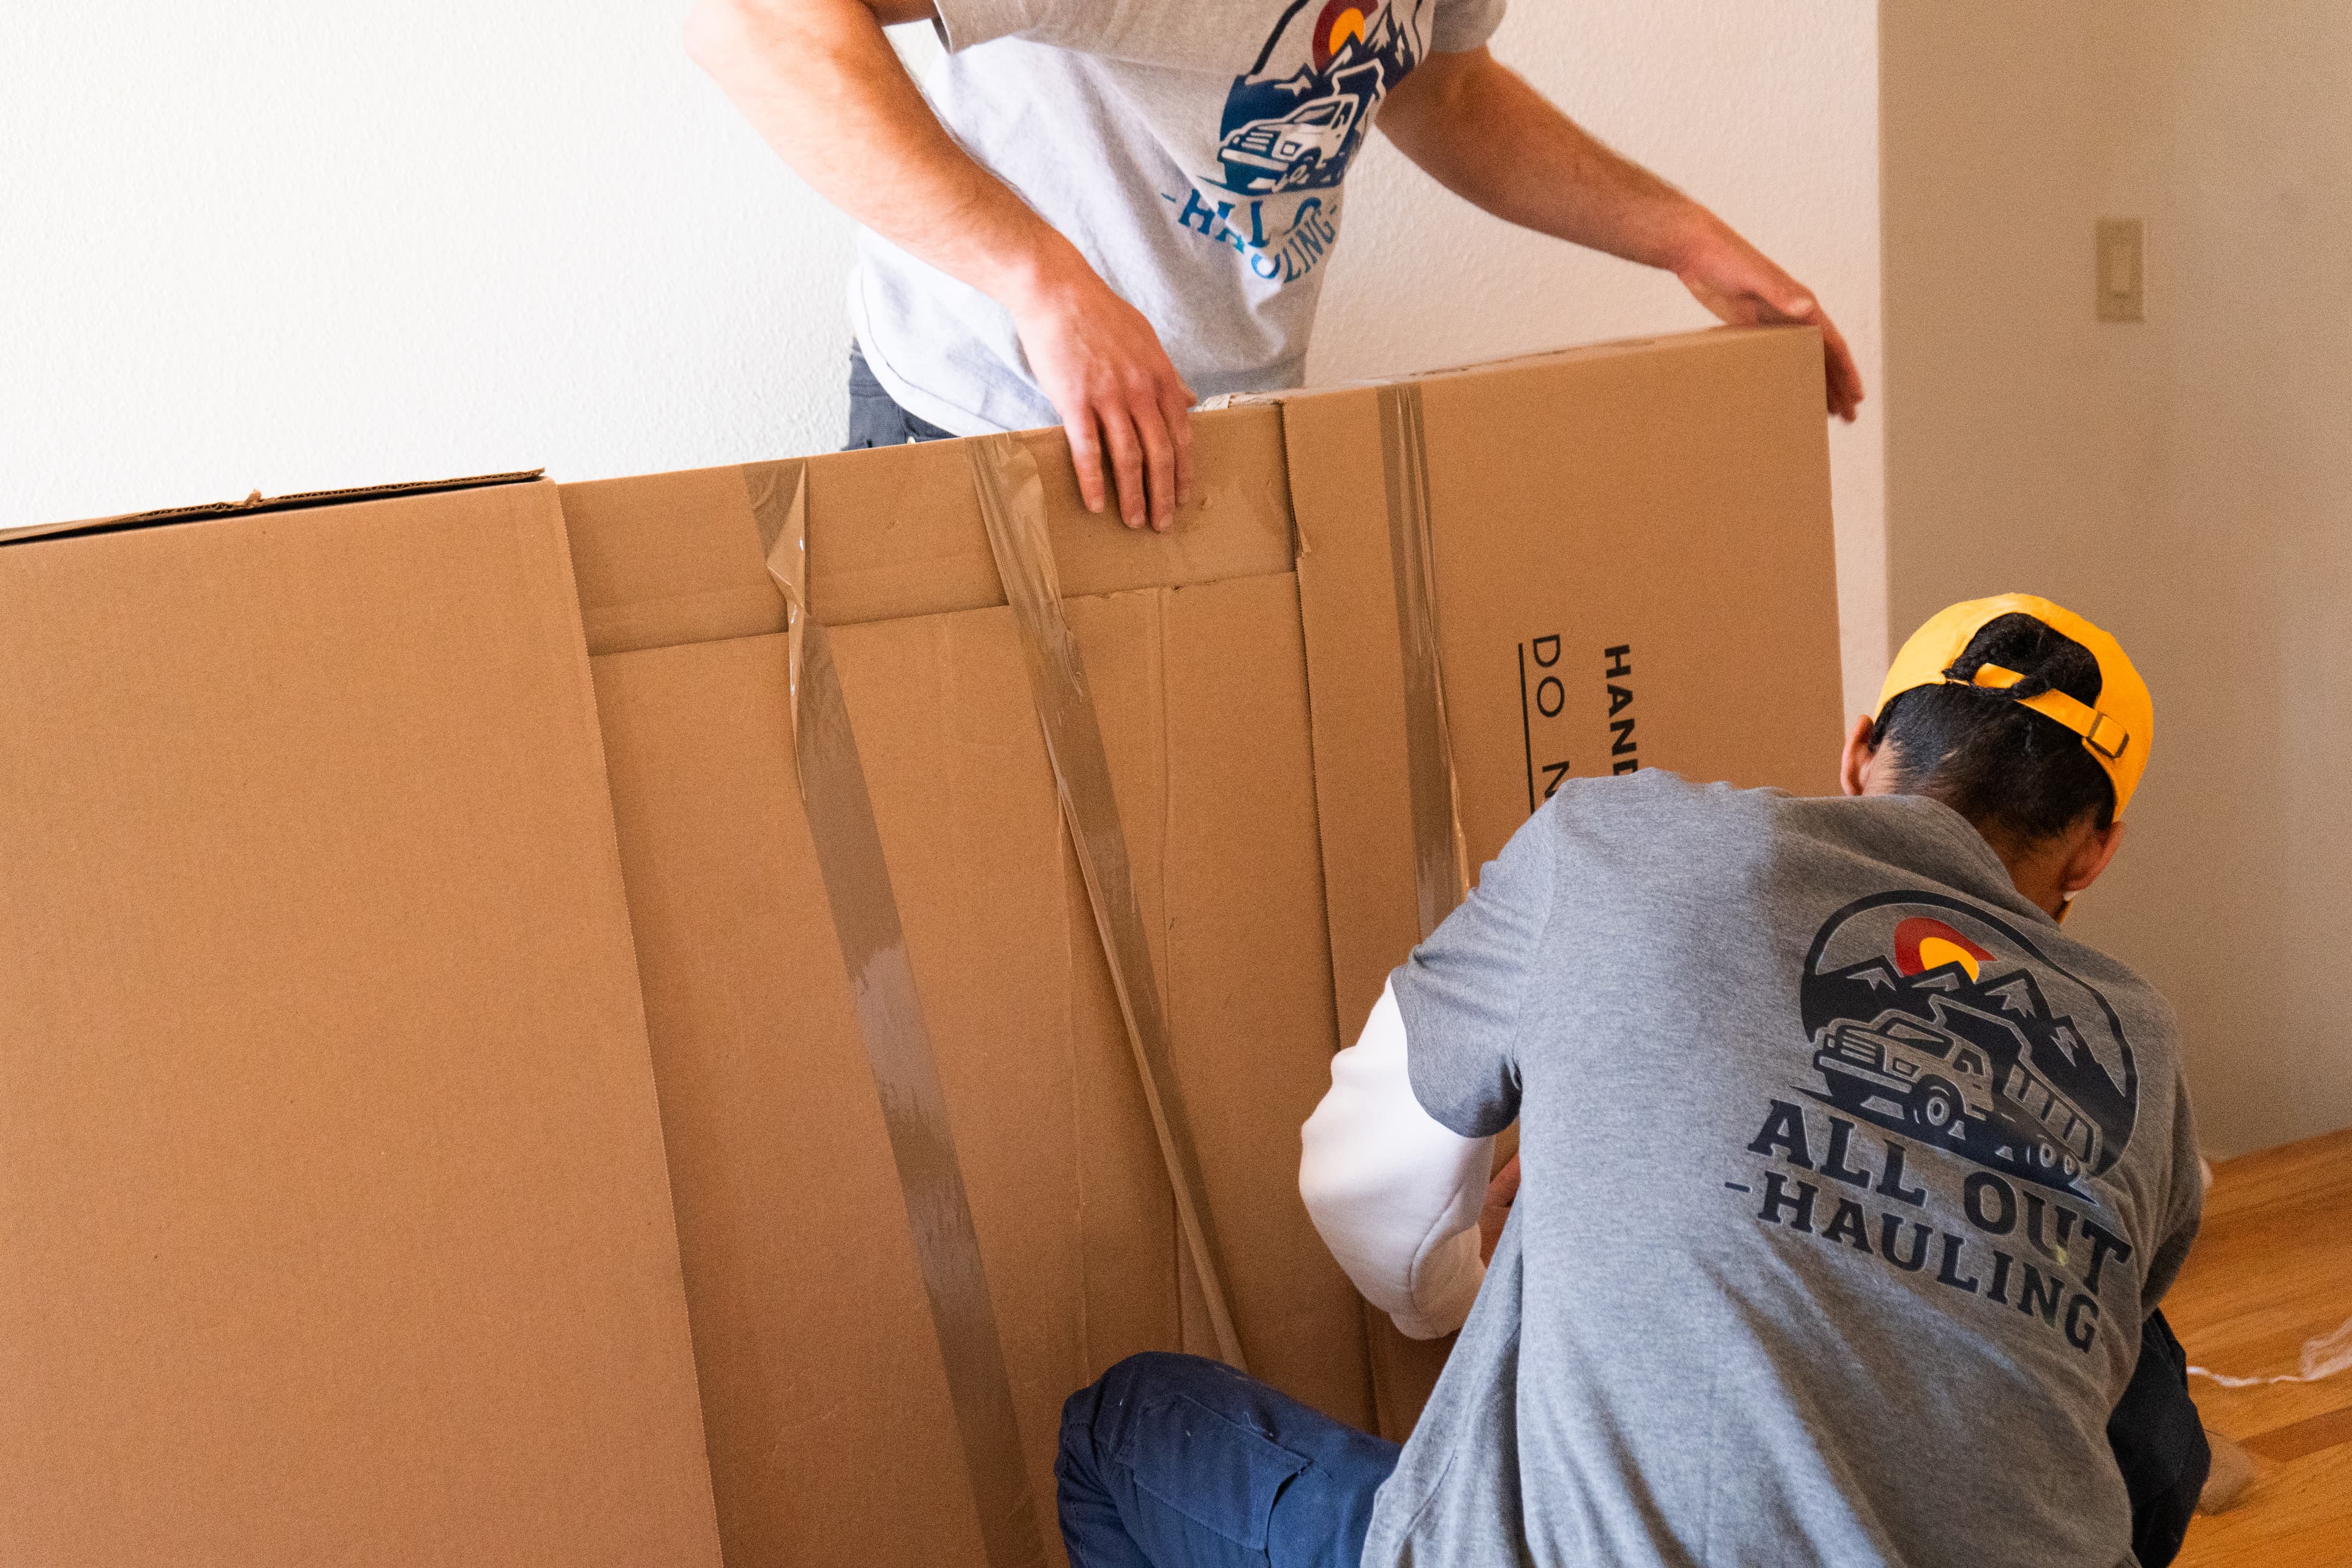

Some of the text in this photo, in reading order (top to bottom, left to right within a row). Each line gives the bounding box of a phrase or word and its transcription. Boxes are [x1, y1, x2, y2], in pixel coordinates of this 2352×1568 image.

[1532, 634, 1564, 717] DO
[1747, 1099, 2133, 1295] ALL OUT
